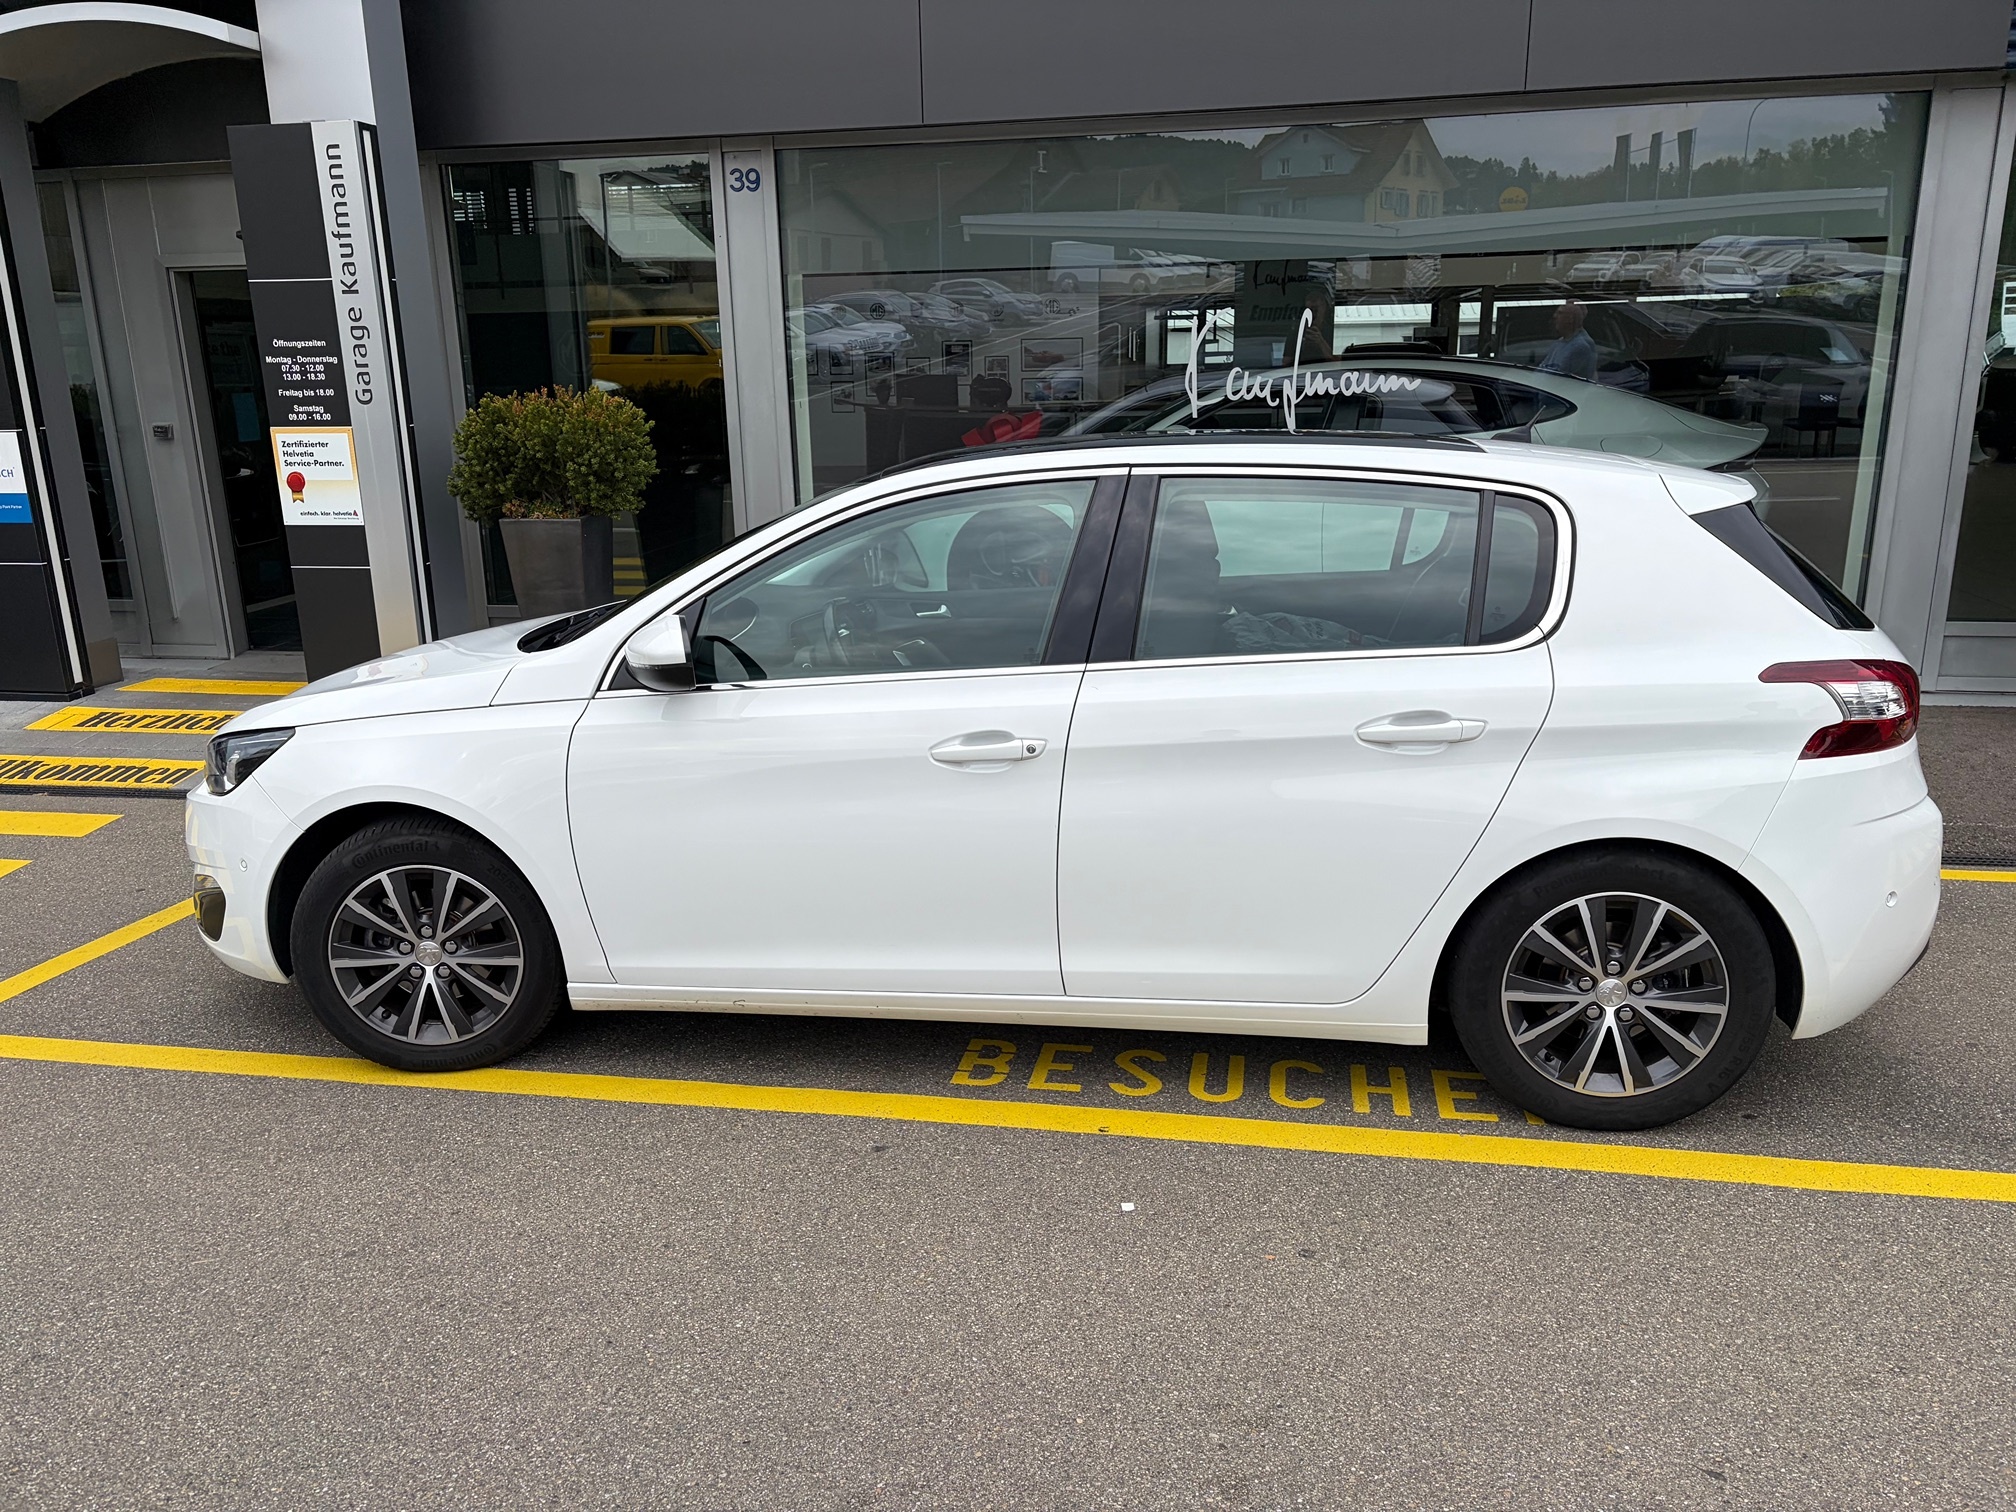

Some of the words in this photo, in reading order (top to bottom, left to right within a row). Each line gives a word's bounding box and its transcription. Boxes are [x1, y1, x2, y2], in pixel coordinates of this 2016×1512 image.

[729, 167, 761, 193] 39
[326, 143, 360, 295] Kaufmann
[273, 339, 326, 348] Öffnungszeiten
[265, 356, 292, 364] Montag
[296, 355, 338, 364] Donnerstag
[348, 306, 373, 406] Garage
[281, 364, 300, 372] 07.30
[278, 389, 303, 398] Freitag
[293, 405, 324, 413] Samstag
[281, 440, 329, 448] Zertifizierter
[282, 450, 314, 458] Helvetia
[284, 459, 344, 467] Service-Partner.
[352, 840, 430, 869] Continental
[950, 1038, 1545, 1126] BESUCHE
